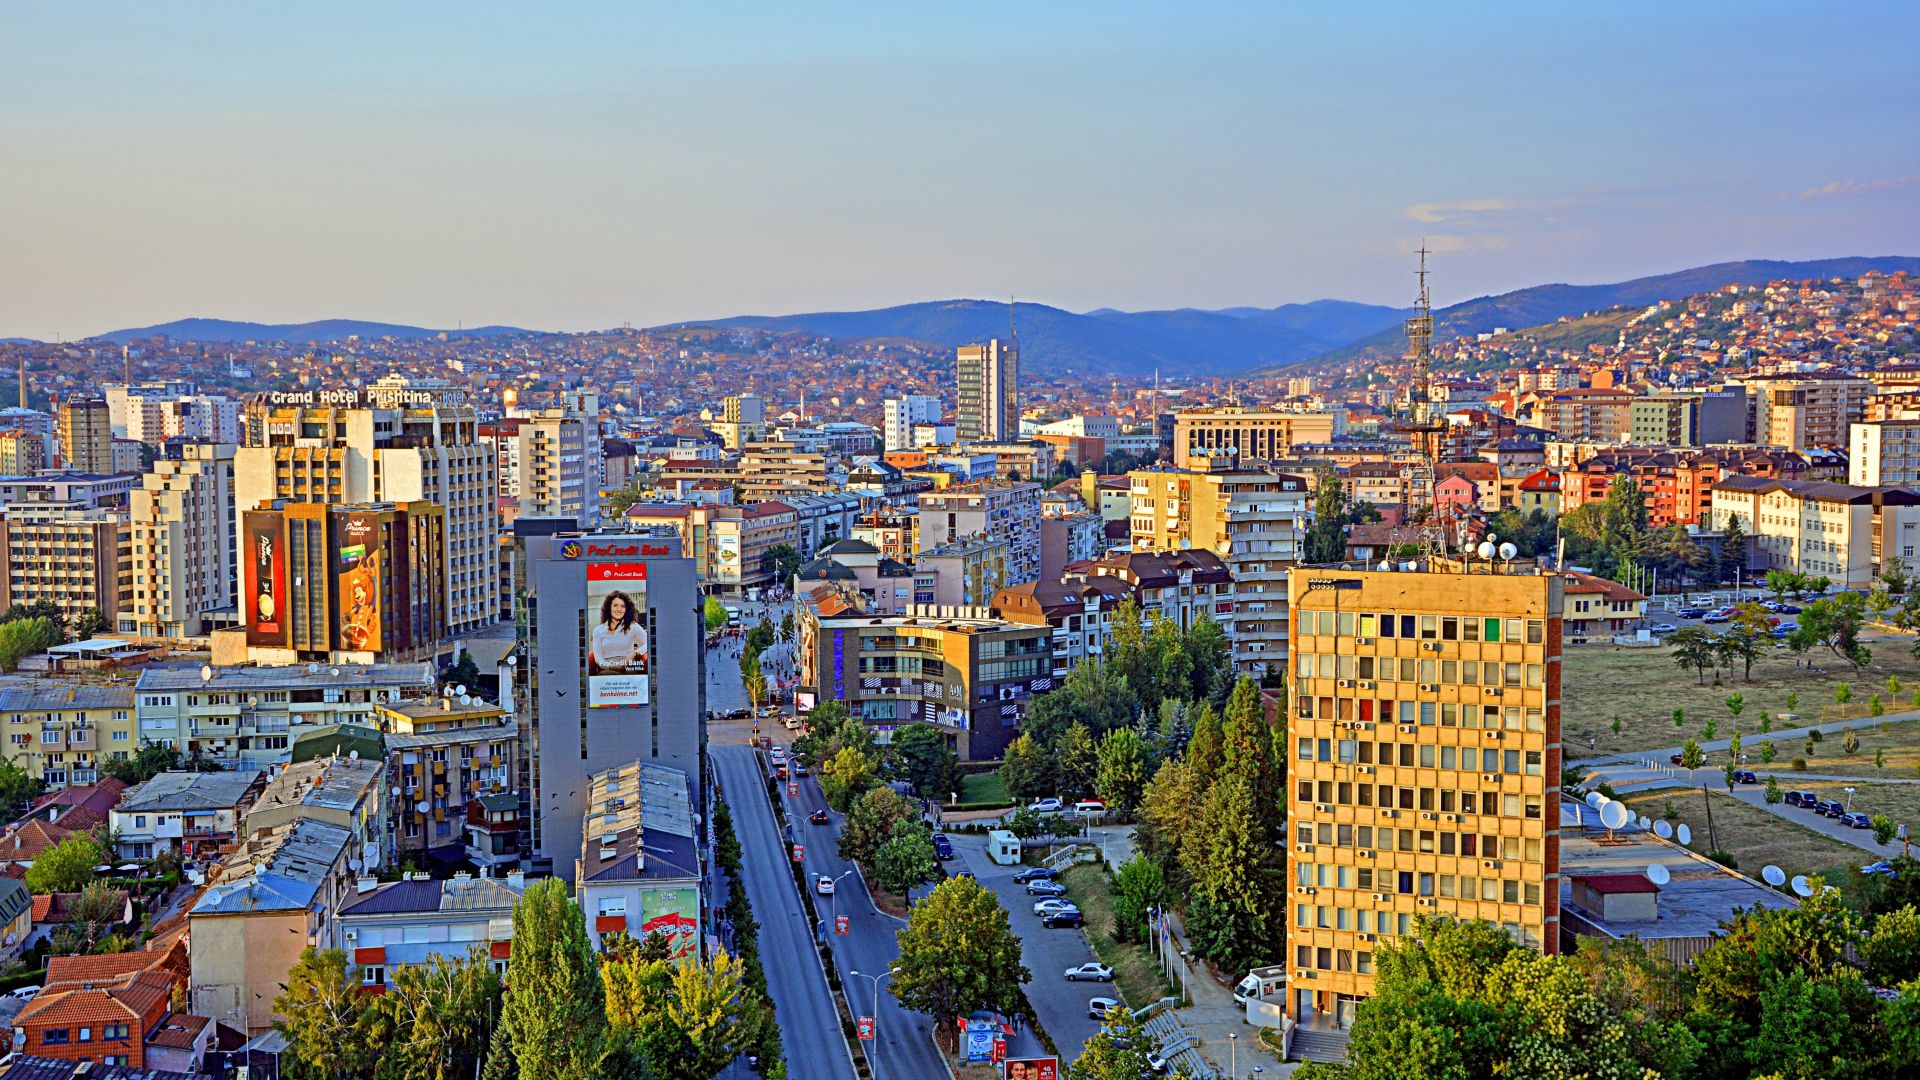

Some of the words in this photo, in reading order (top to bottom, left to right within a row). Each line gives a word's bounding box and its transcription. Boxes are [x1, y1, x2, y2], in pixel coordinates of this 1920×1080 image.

[271, 391, 313, 403] Grand
[320, 389, 358, 403] Hotel
[367, 390, 431, 403] Prishtina
[345, 522, 371, 531] Prince
[587, 543, 639, 556] ProCredit
[641, 543, 669, 556] Bank
[833, 682, 845, 699] LC
